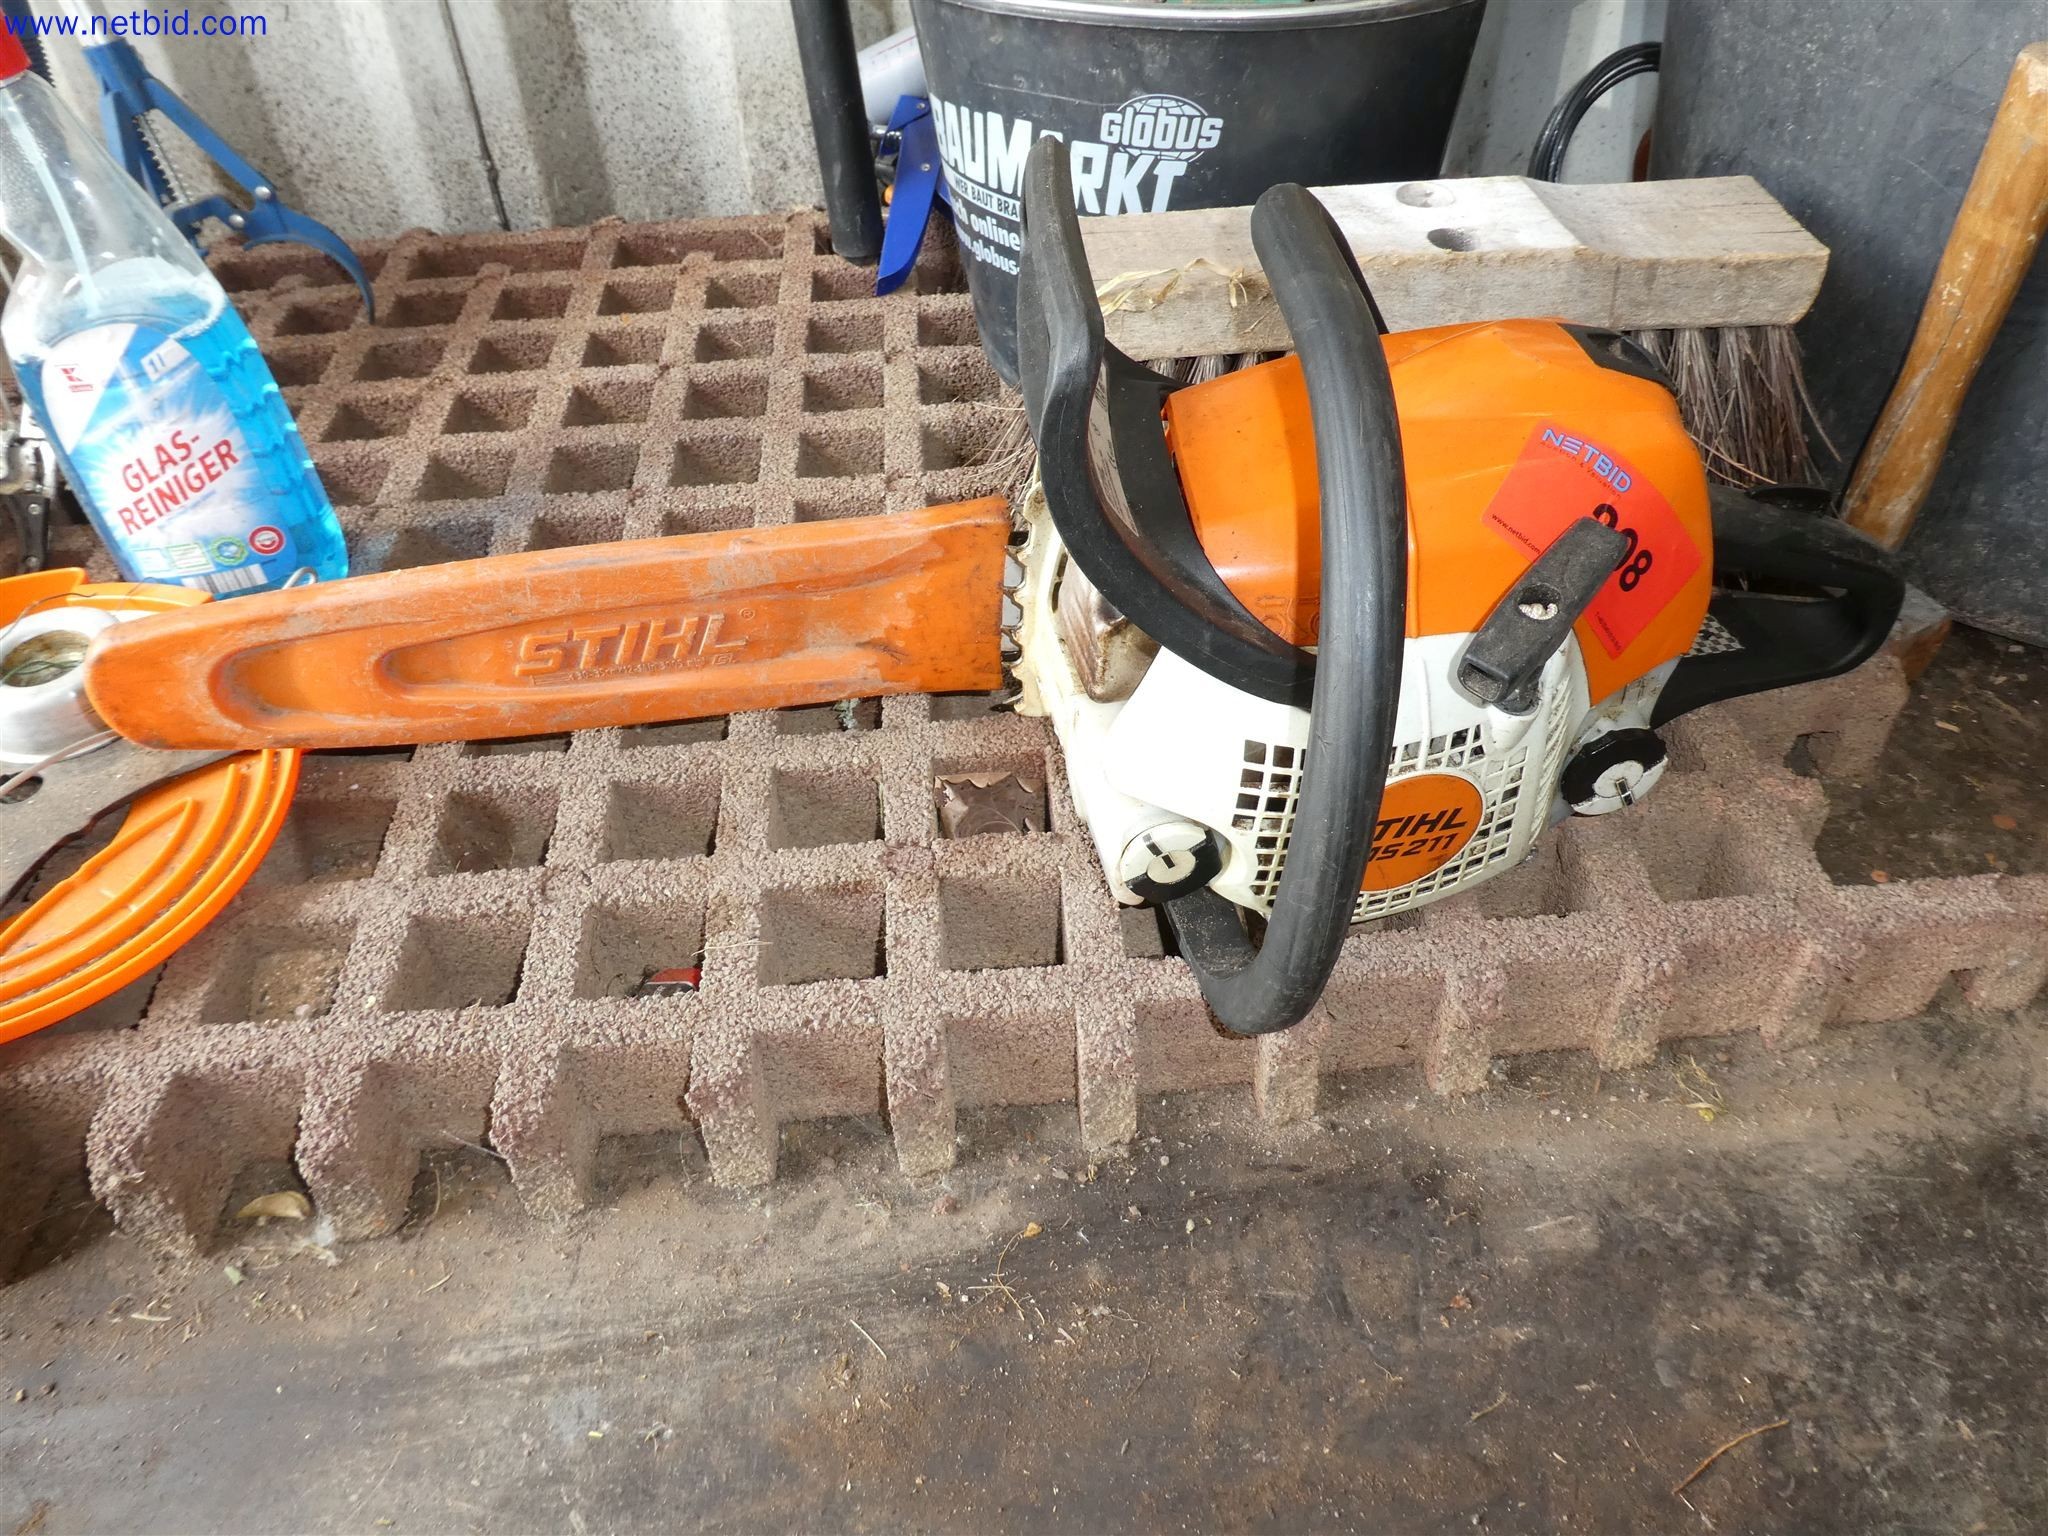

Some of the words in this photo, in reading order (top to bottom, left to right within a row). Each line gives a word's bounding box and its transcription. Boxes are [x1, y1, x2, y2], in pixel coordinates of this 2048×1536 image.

[929, 92, 1188, 217] BAUMRKT
[970, 214, 1020, 251] online
[971, 186, 993, 209] BAUT
[997, 198, 1020, 219] BRA
[117, 439, 240, 536] REINIGER
[122, 429, 200, 493] GLAS-
[1541, 427, 1632, 493] NETBID
[514, 613, 749, 677] STIHL
[1373, 807, 1468, 842] TIHL
